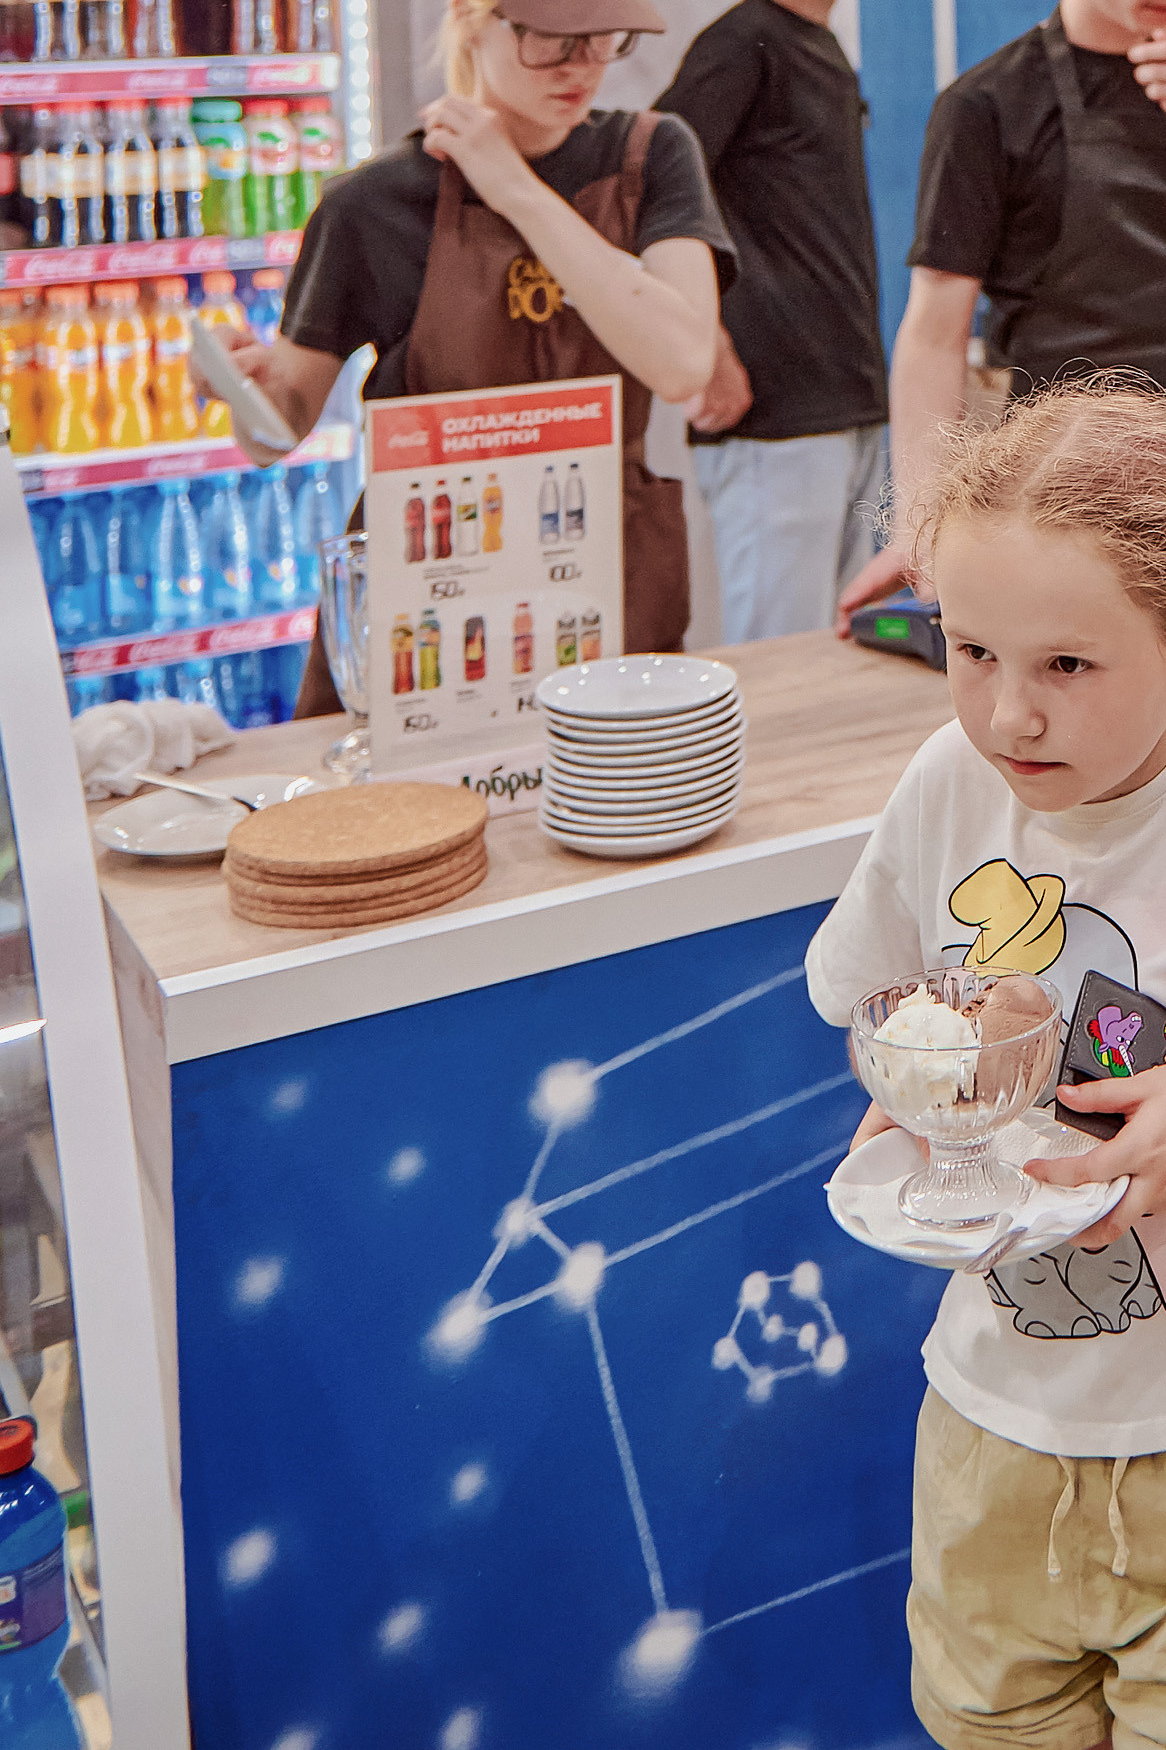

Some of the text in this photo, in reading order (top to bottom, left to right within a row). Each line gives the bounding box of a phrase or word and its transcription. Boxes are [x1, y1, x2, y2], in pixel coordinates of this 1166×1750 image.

[442, 402, 603, 435] ОХЛАЖДЕННЫЕ
[442, 427, 541, 453] НАПИТКИ
[461, 765, 544, 802] обры
